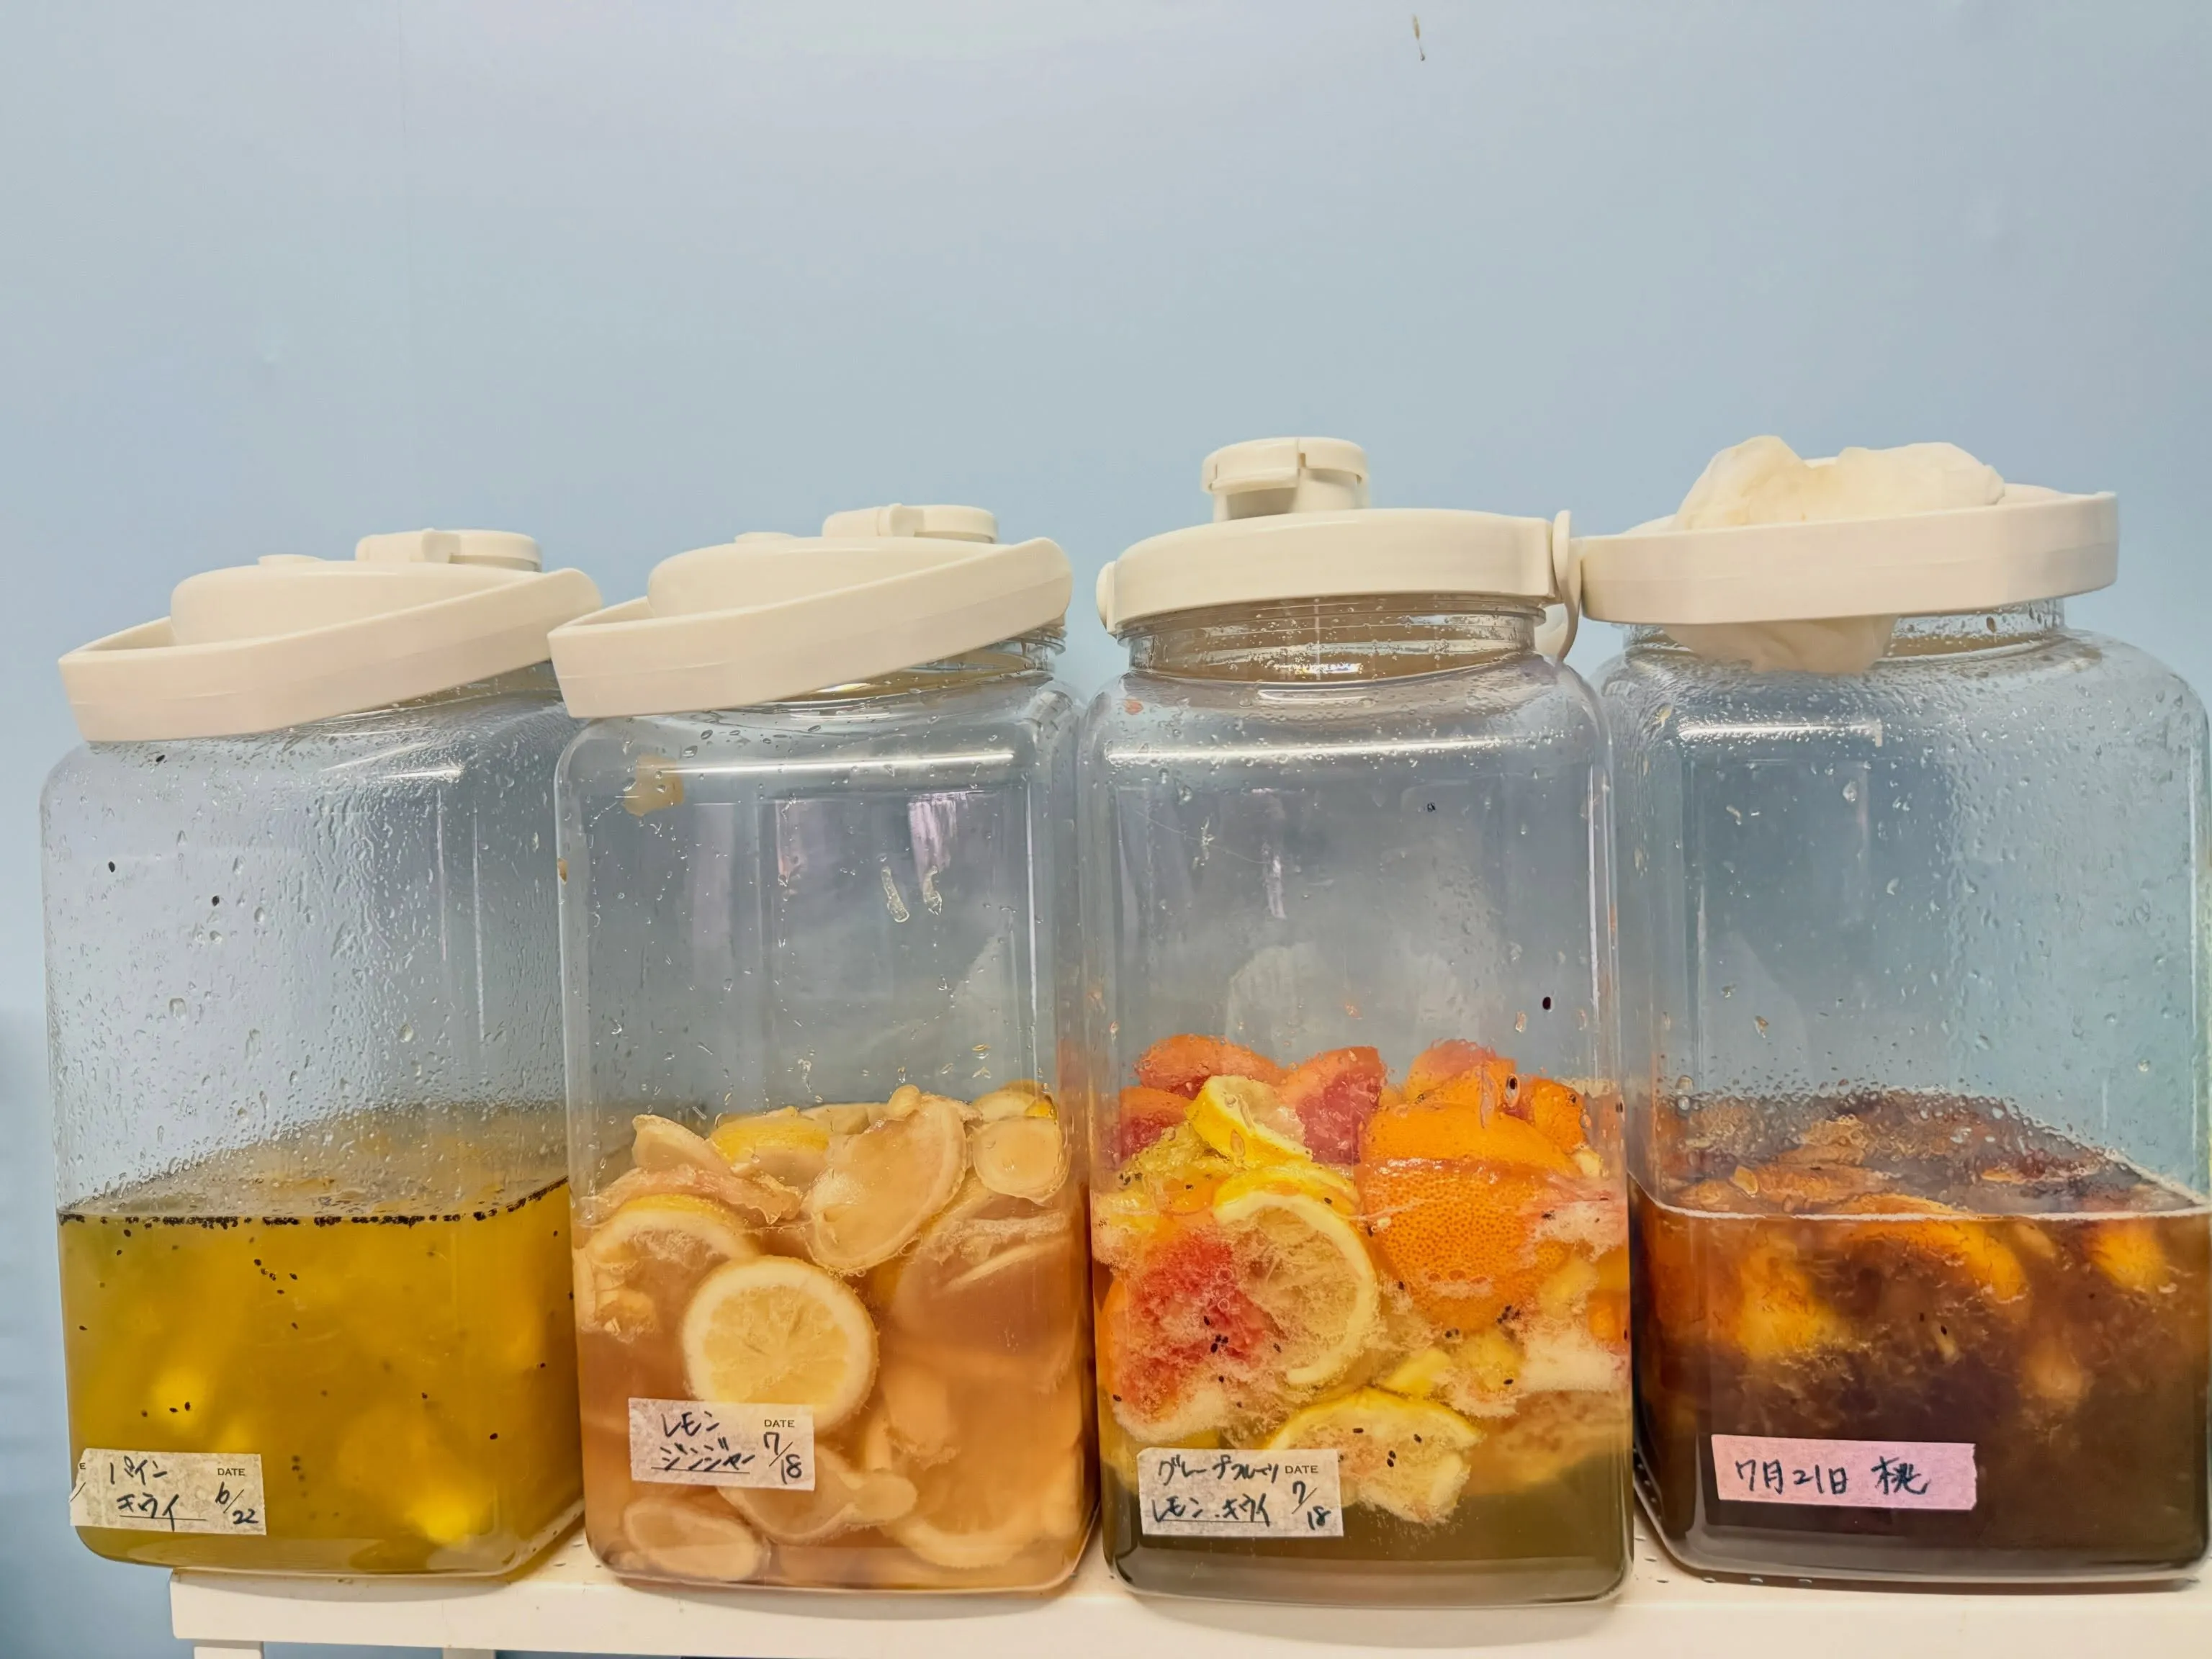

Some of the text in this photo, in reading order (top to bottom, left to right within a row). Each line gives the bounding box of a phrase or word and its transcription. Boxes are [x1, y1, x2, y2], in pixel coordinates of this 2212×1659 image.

[660, 1411, 720, 1437] レモン
[764, 1419, 795, 1428] DATE
[109, 1455, 168, 1485] パイン
[217, 1468, 246, 1477] DATE
[1285, 1465, 1319, 1474] DATE
[1735, 1456, 1932, 1495] 7月21日 桃
[116, 1493, 179, 1532] キウイ
